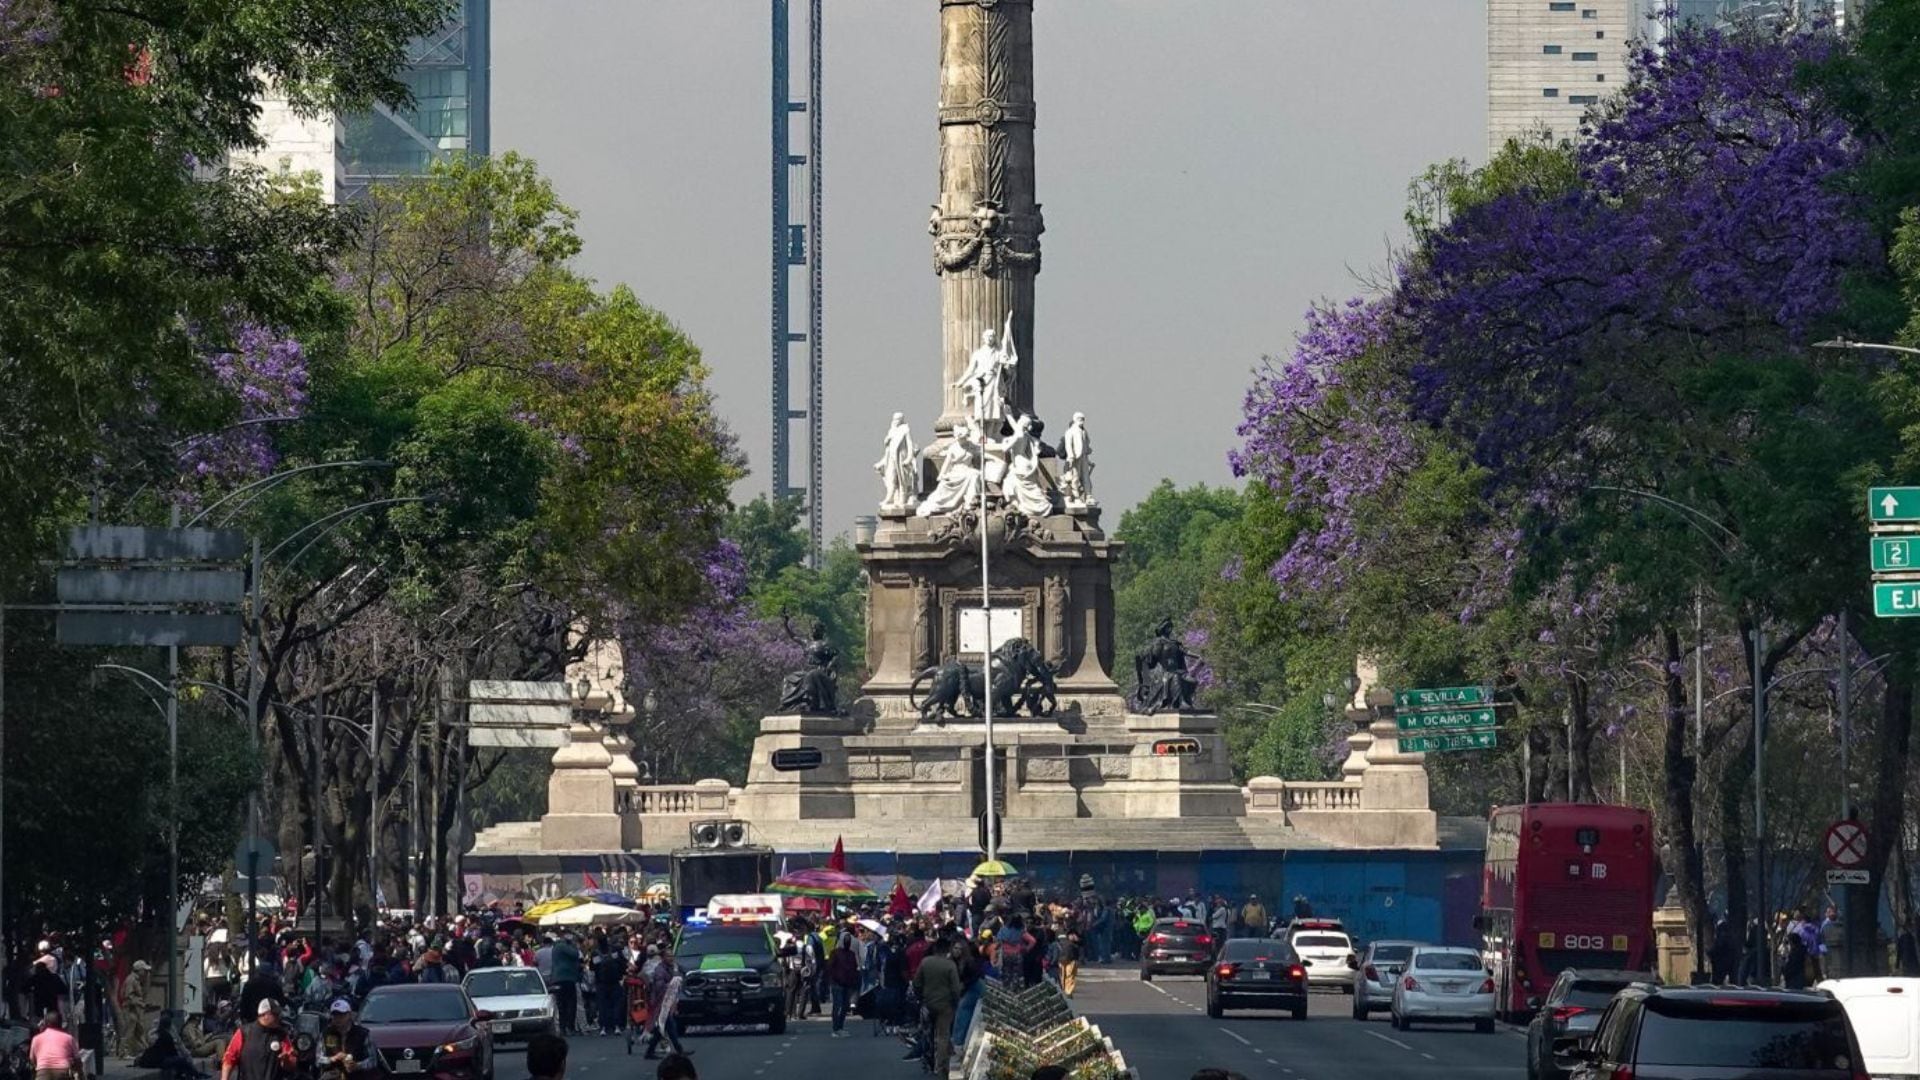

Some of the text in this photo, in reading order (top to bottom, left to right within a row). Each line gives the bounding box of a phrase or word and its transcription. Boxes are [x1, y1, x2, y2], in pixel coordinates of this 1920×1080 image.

[1891, 548, 1902, 560] 2
[1892, 590, 1920, 610] EJ
[1420, 692, 1466, 703] SEVILLA
[1408, 714, 1472, 726] M OCAMPO
[1446, 736, 1474, 747] TIBER
[1564, 935, 1604, 949] 803
